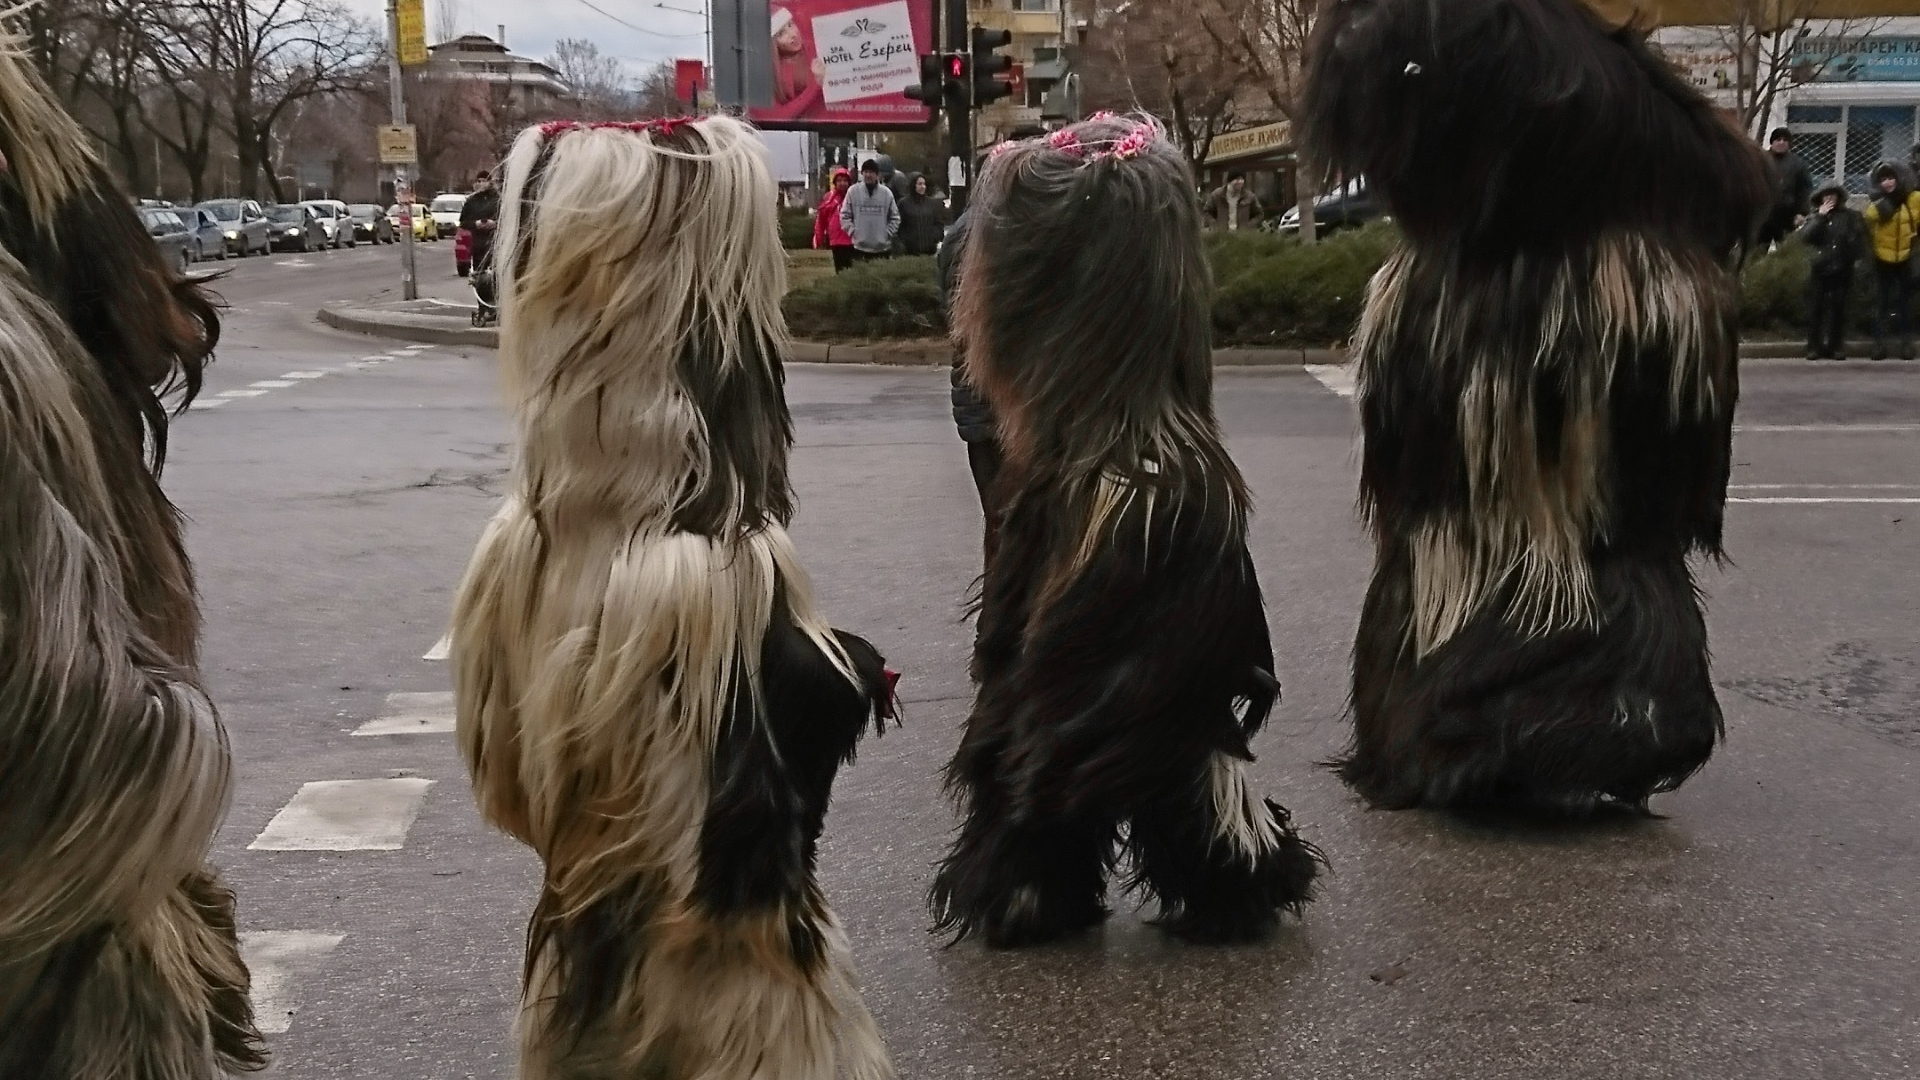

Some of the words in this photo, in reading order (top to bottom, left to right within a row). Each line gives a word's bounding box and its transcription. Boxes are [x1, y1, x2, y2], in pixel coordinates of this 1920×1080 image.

[823, 53, 854, 64] HOTEL
[859, 41, 912, 61] Езерец
[830, 46, 844, 54] SPA
